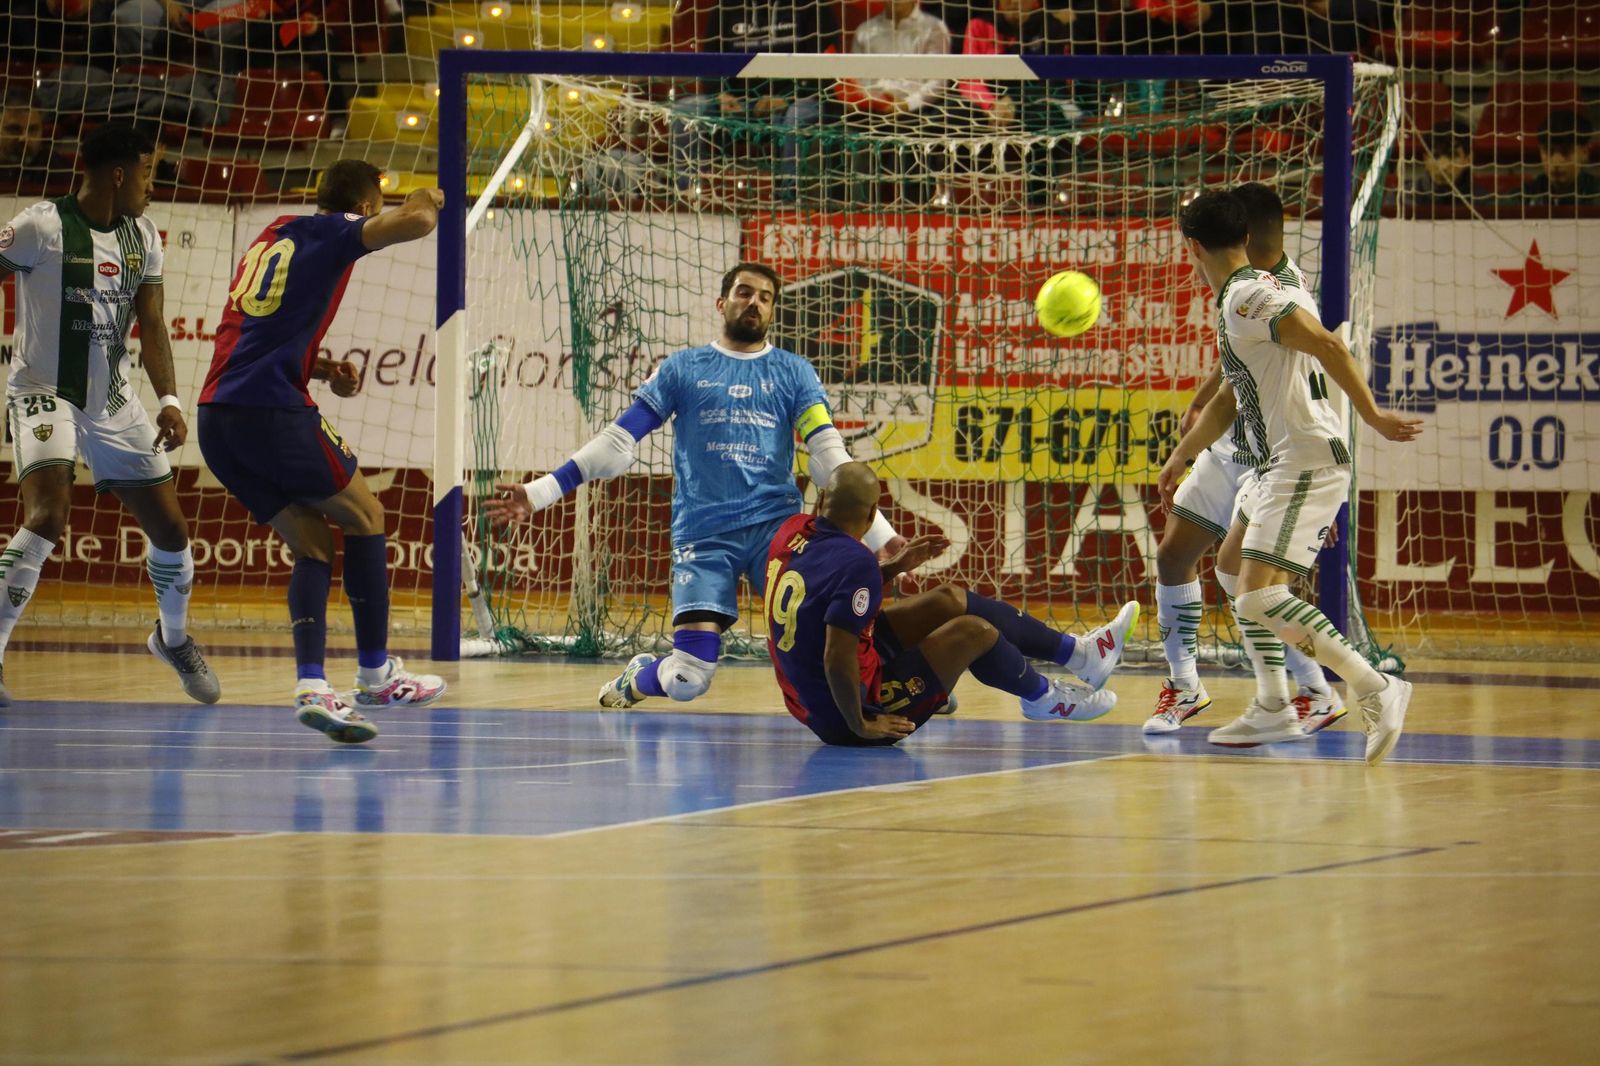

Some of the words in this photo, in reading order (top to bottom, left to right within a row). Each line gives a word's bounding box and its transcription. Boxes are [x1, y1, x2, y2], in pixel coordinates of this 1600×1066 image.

[916, 226, 954, 262] DE
[962, 228, 1116, 263] SERVICIOS
[229, 237, 296, 317] 10
[956, 339, 988, 374] La
[1126, 343, 1217, 378] SEVILL
[1386, 341, 1600, 391] Heinek
[24, 395, 57, 417] 25
[1489, 415, 1566, 472] 0.0
[764, 558, 806, 653] 19
